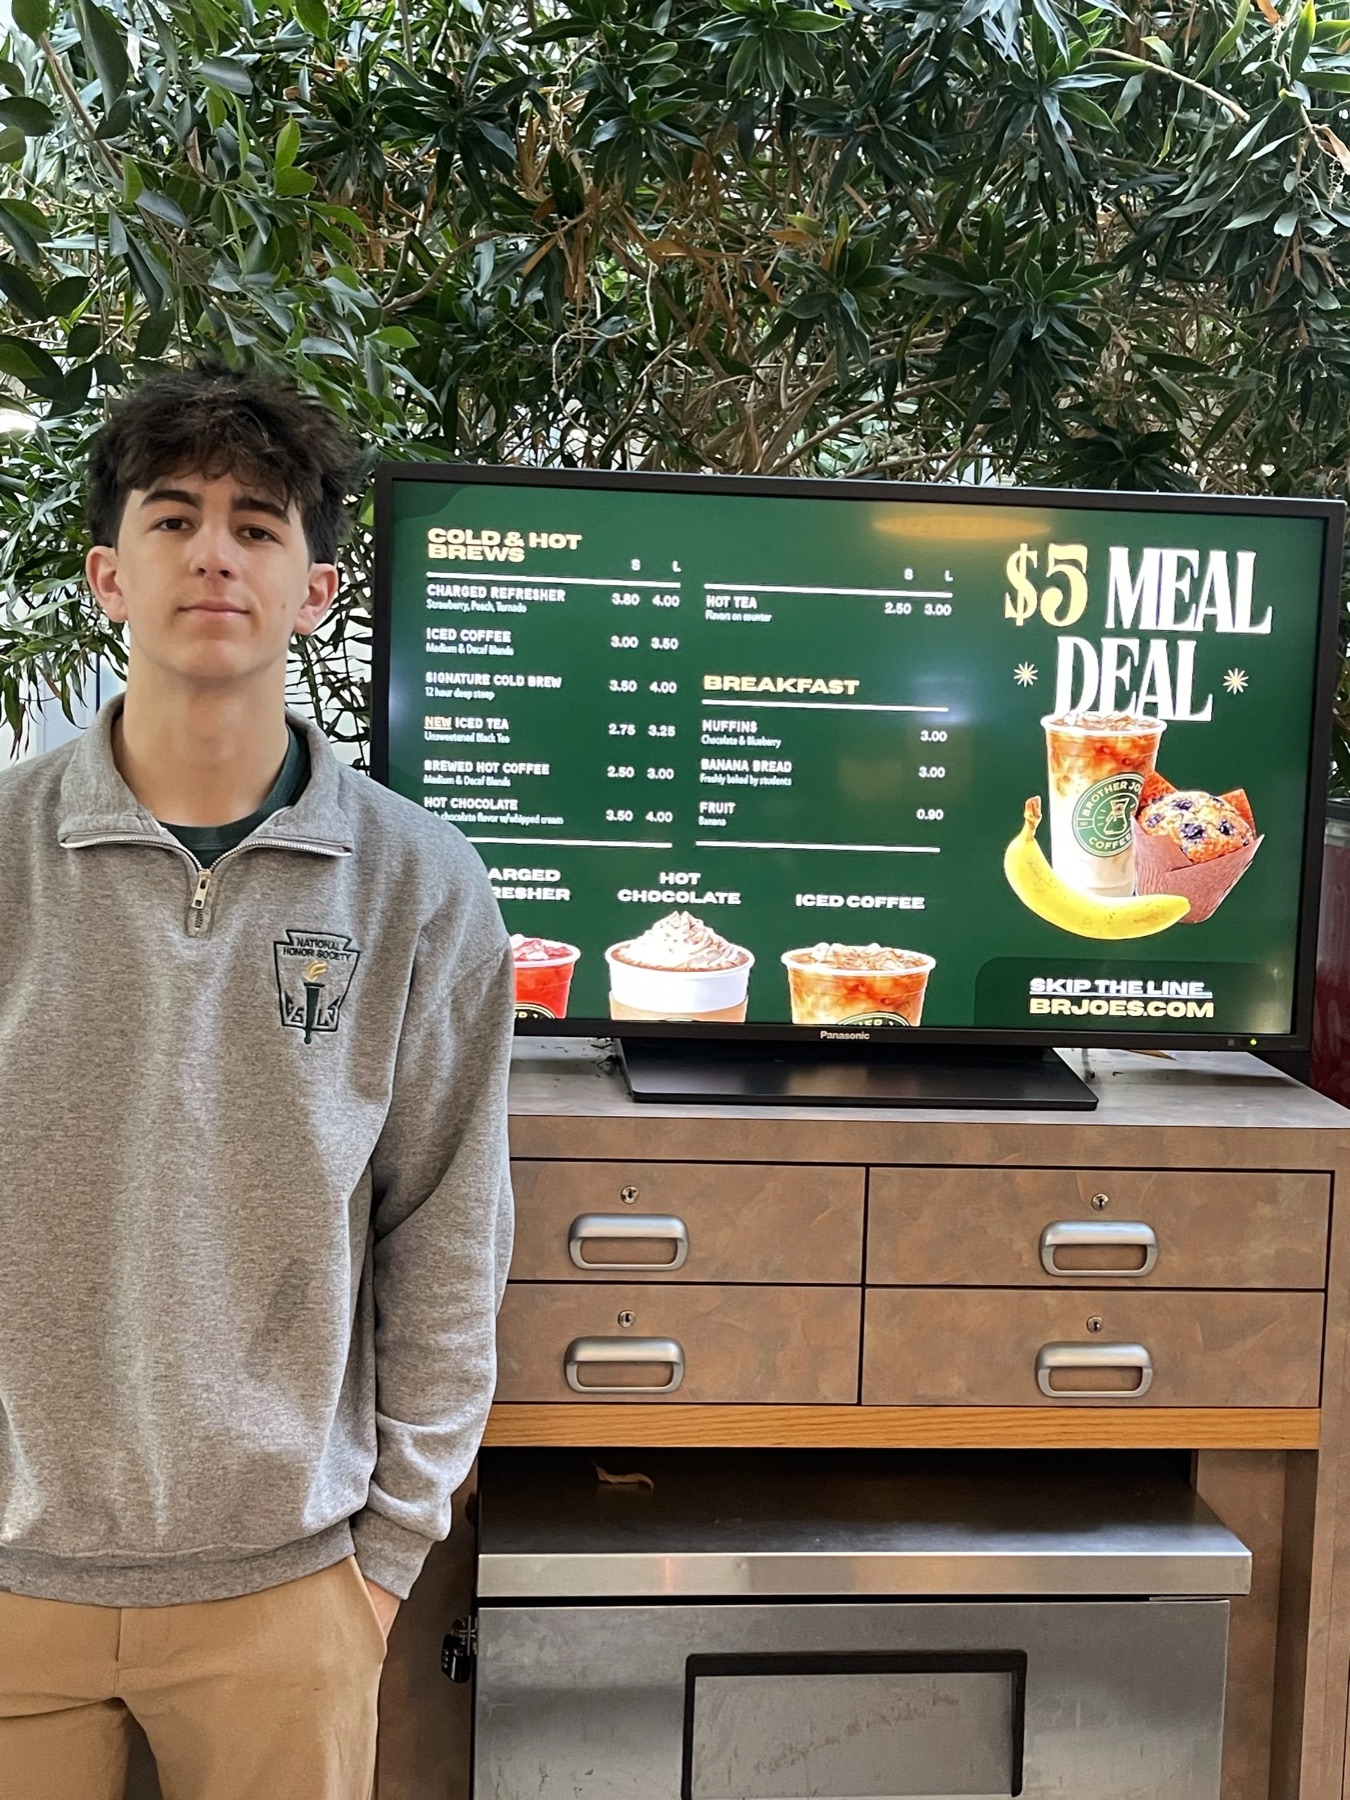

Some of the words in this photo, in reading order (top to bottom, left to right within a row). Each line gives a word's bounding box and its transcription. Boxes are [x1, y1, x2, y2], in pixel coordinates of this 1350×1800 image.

[427, 528, 501, 546] COLD
[504, 531, 524, 547] &
[529, 532, 582, 550] HOT
[428, 544, 525, 562] BREWS
[631, 558, 641, 571] S
[672, 560, 682, 573] L
[904, 568, 913, 581] S
[944, 569, 953, 582] L
[427, 583, 487, 599] CHARGED
[490, 586, 566, 603] REFRESHER
[1004, 543, 1088, 627] $5
[1105, 546, 1272, 634] MEAL
[426, 598, 470, 613] Strawberry,
[470, 600, 495, 613] Peach,
[496, 601, 527, 613] Tornado
[652, 594, 680, 608] 4.00
[706, 594, 731, 609] HOT
[733, 595, 758, 610] TEA
[885, 601, 912, 615] 2.50
[924, 603, 952, 616] 3.00
[705, 609, 731, 621] Flavors
[732, 613, 742, 621] on
[743, 613, 772, 622] counter
[426, 627, 457, 641] ICED
[460, 629, 511, 643] COFFEE
[610, 635, 638, 648] 3.00
[651, 637, 679, 650] 3.50
[425, 642, 457, 654] Medium
[458, 643, 465, 654] &
[466, 643, 488, 655] Decaf
[488, 645, 514, 656] Blends
[425, 671, 491, 686] SIGNATURE
[493, 674, 525, 687] COLD
[527, 675, 562, 689] BREW
[703, 675, 860, 695] BREAKFAST
[1054, 636, 1213, 721] DEAL
[425, 687, 434, 697] 12
[435, 687, 453, 698] hour
[453, 687, 473, 701] deep
[473, 690, 495, 701] steep
[609, 679, 637, 693] 3.50
[649, 681, 677, 694] 4.00
[424, 716, 452, 728] NEW
[455, 717, 483, 729] ICED
[486, 718, 509, 730] TEA
[608, 723, 636, 736] 2.75
[648, 724, 676, 737] 3.25
[702, 719, 758, 733] MUFFINS
[424, 731, 475, 742] Unsweetened
[476, 732, 496, 743] Black
[497, 733, 510, 744] Tea
[701, 734, 737, 746] Chocolate
[738, 735, 746, 746] &
[746, 736, 781, 749] Blueberry
[920, 730, 948, 742] 3.00
[423, 759, 473, 773] BREWED
[476, 761, 500, 774] HOT
[502, 762, 550, 775] COFFEE
[607, 765, 635, 778] 2.50
[646, 767, 674, 780] 3.00
[701, 758, 749, 772] BANANA
[752, 759, 792, 773] BREAD
[918, 766, 945, 778] 3.00
[423, 774, 454, 785] Medium
[455, 775, 463, 785] &
[464, 775, 485, 786] Decaf
[486, 776, 511, 787] Blends
[699, 773, 726, 785] Freshly
[726, 774, 748, 785] baked
[749, 775, 758, 787] by
[759, 776, 792, 786] students
[424, 796, 448, 808] HOT
[450, 797, 518, 811] CHOCOLATE
[1082, 781, 1127, 817] BROTHER
[699, 801, 736, 815] FRUIT
[916, 808, 944, 821] 0.90
[477, 812, 499, 823] flavor
[499, 813, 540, 826] w/whipped
[541, 815, 564, 825] cream
[606, 809, 634, 822] 3.50
[645, 811, 673, 823] 4.00
[698, 815, 727, 826] Banana
[1088, 832, 1132, 850] COFFEE
[488, 867, 561, 882] ARGED
[659, 870, 701, 887] HOT
[491, 886, 571, 901] RESHER
[617, 889, 741, 906] CHOCOLATE
[795, 893, 844, 908] ICED
[846, 895, 925, 910] COFFEE
[296, 937, 340, 951] NATIONAL
[283, 946, 315, 957] HONOR
[317, 949, 351, 961] SOCIETY
[1029, 977, 1091, 993] SKIP
[1094, 979, 1143, 995] THE
[1029, 997, 1214, 1018] BRJOES.COM
[820, 1030, 870, 1040] Panasonic
